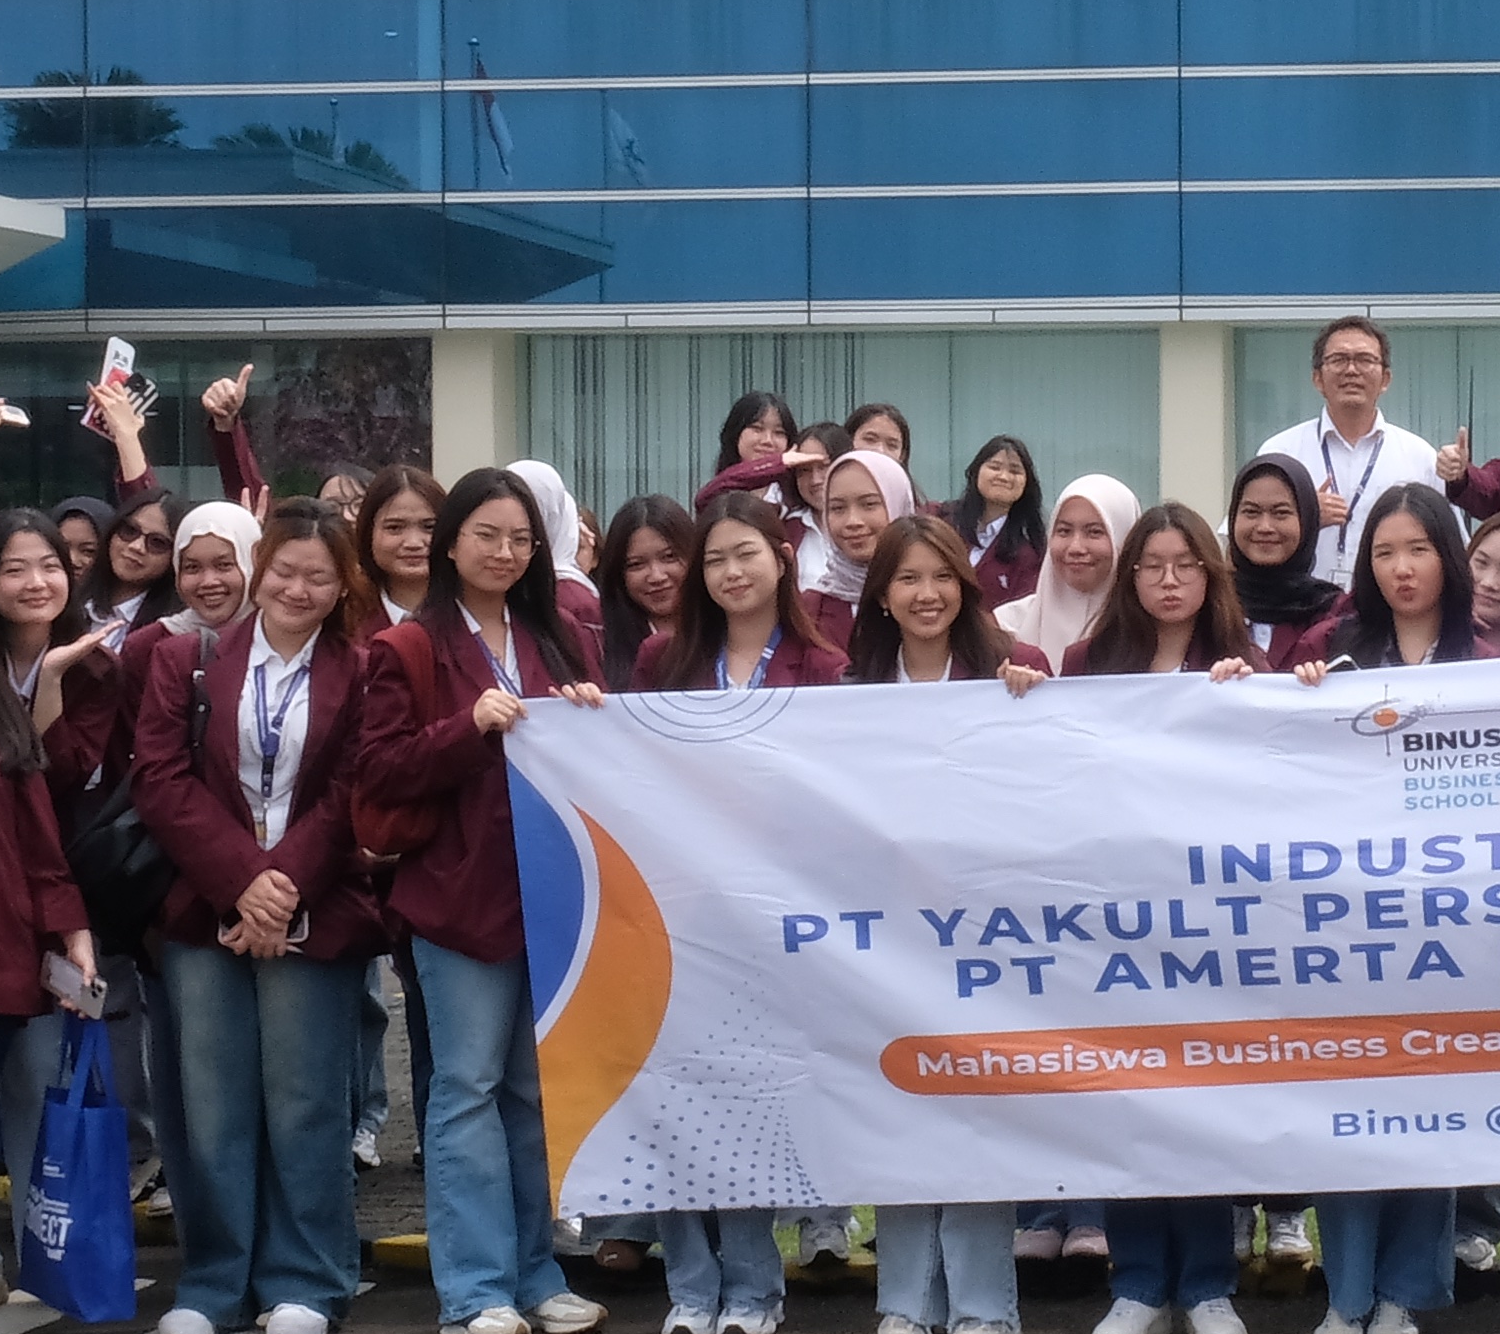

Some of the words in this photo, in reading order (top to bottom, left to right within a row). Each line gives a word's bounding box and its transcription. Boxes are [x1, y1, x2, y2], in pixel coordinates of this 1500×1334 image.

[1404, 792, 1500, 810] SCHOOL
[783, 910, 885, 953] PT
[918, 895, 1263, 948] YAKULT
[956, 954, 1057, 998] PT
[1094, 940, 1465, 993] AMERTA
[918, 1043, 1167, 1075] Mahasiswa
[1183, 1034, 1387, 1065] Business
[1333, 1107, 1468, 1137] Binus
